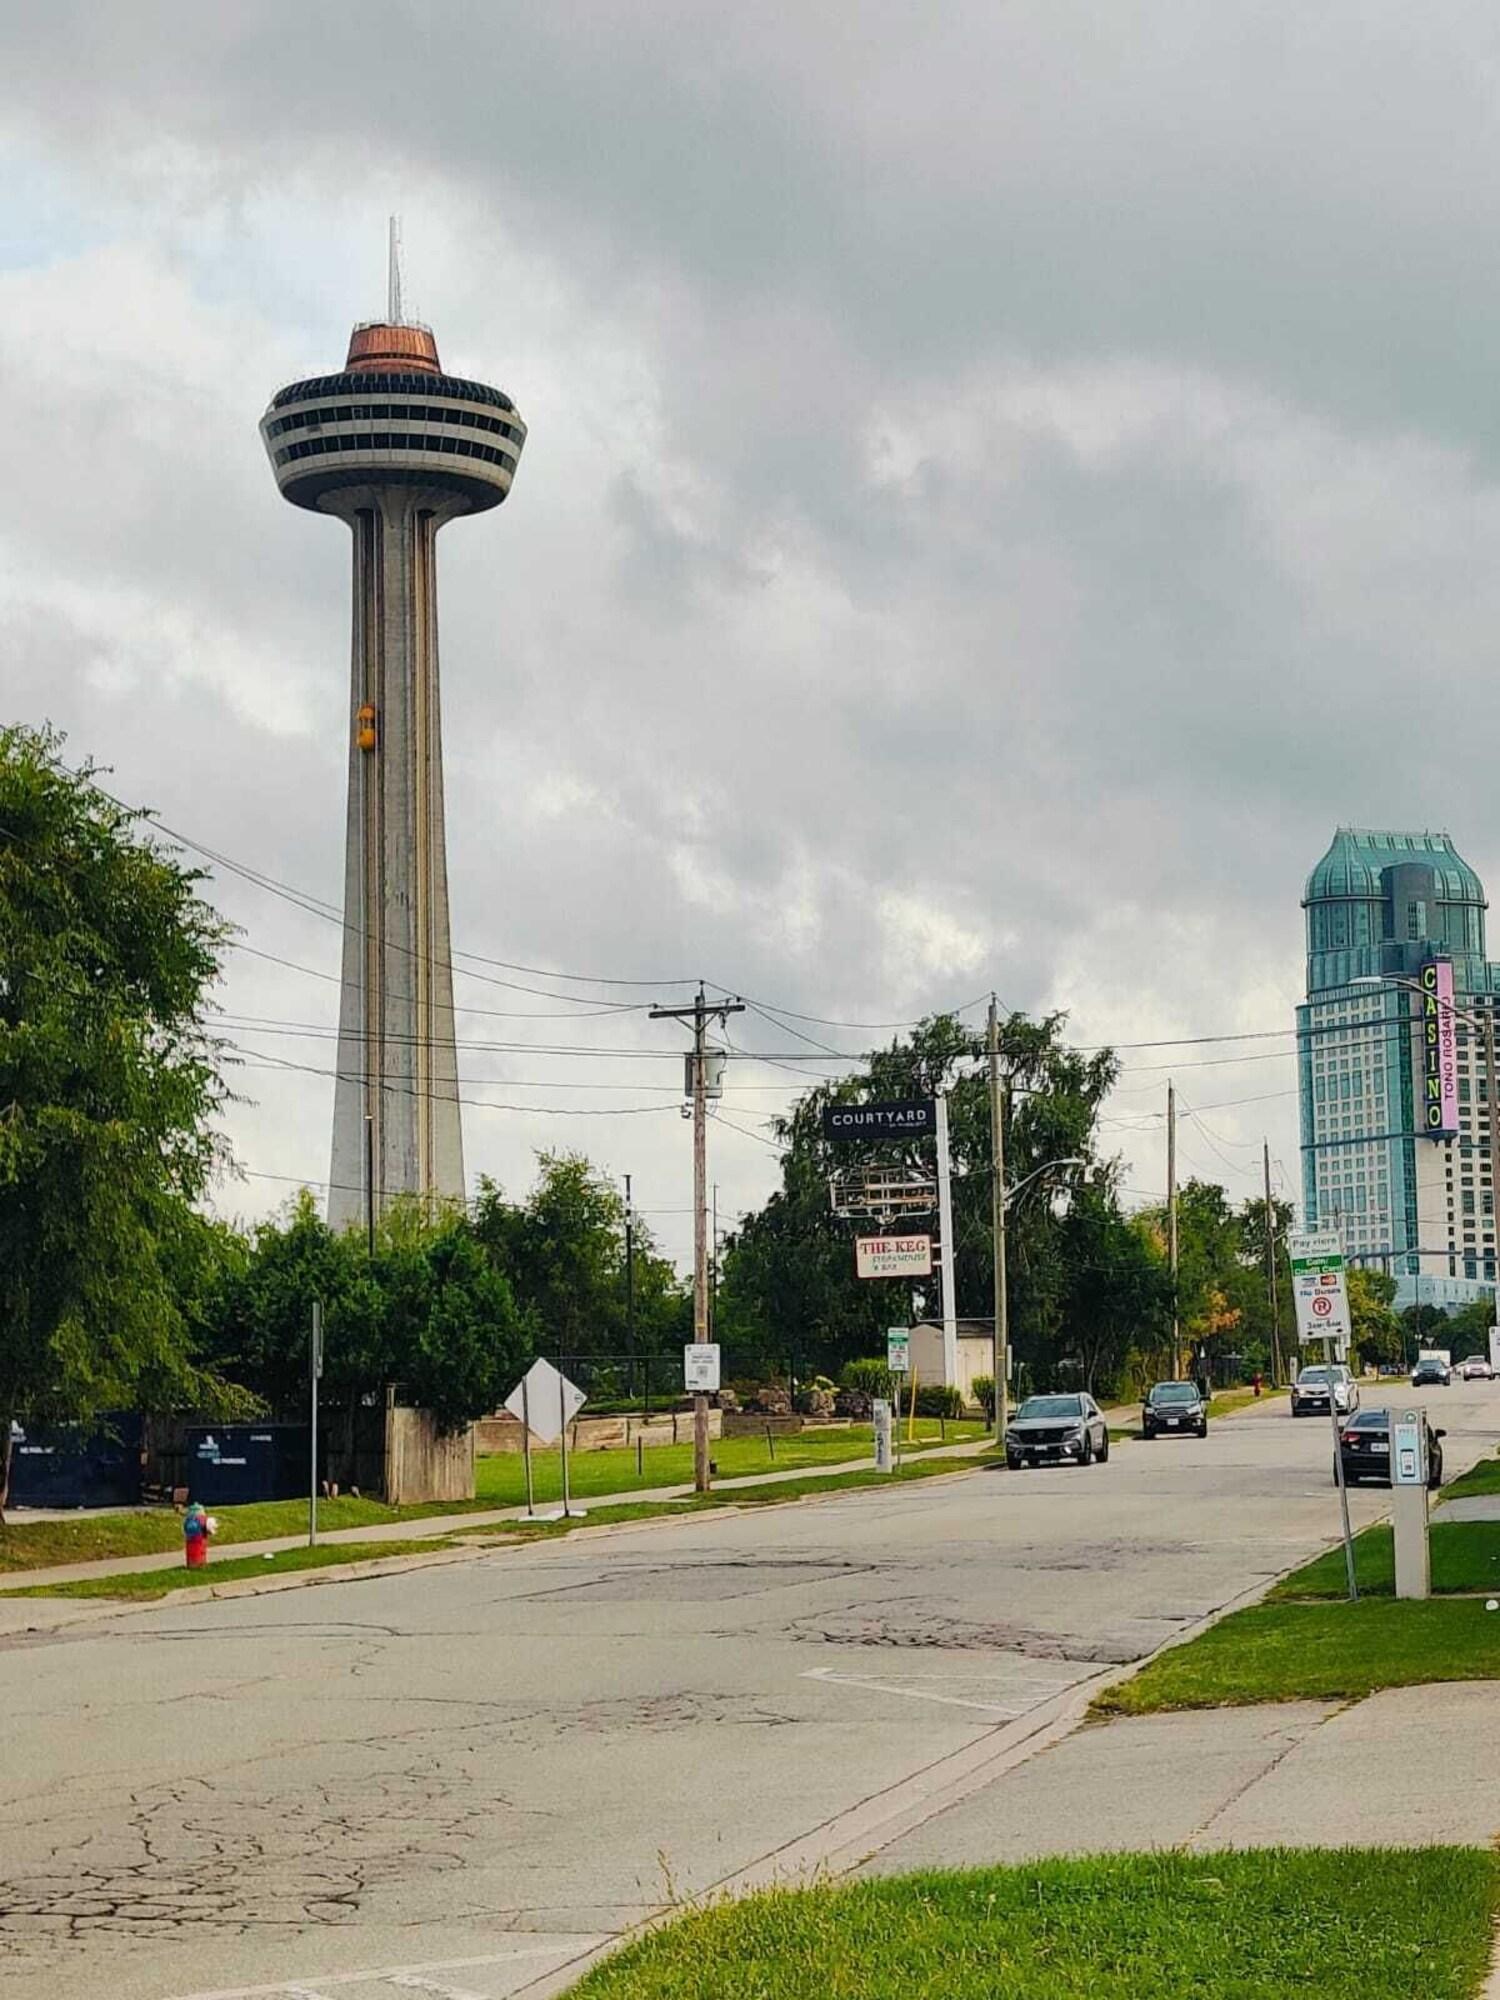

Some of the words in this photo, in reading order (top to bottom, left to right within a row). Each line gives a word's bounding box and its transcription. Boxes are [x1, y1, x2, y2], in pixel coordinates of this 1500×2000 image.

[1424, 967, 1441, 1126] CASINO
[832, 1110, 926, 1126] COURTYARD
[860, 1242, 891, 1255] THE
[895, 1240, 926, 1252] KEG
